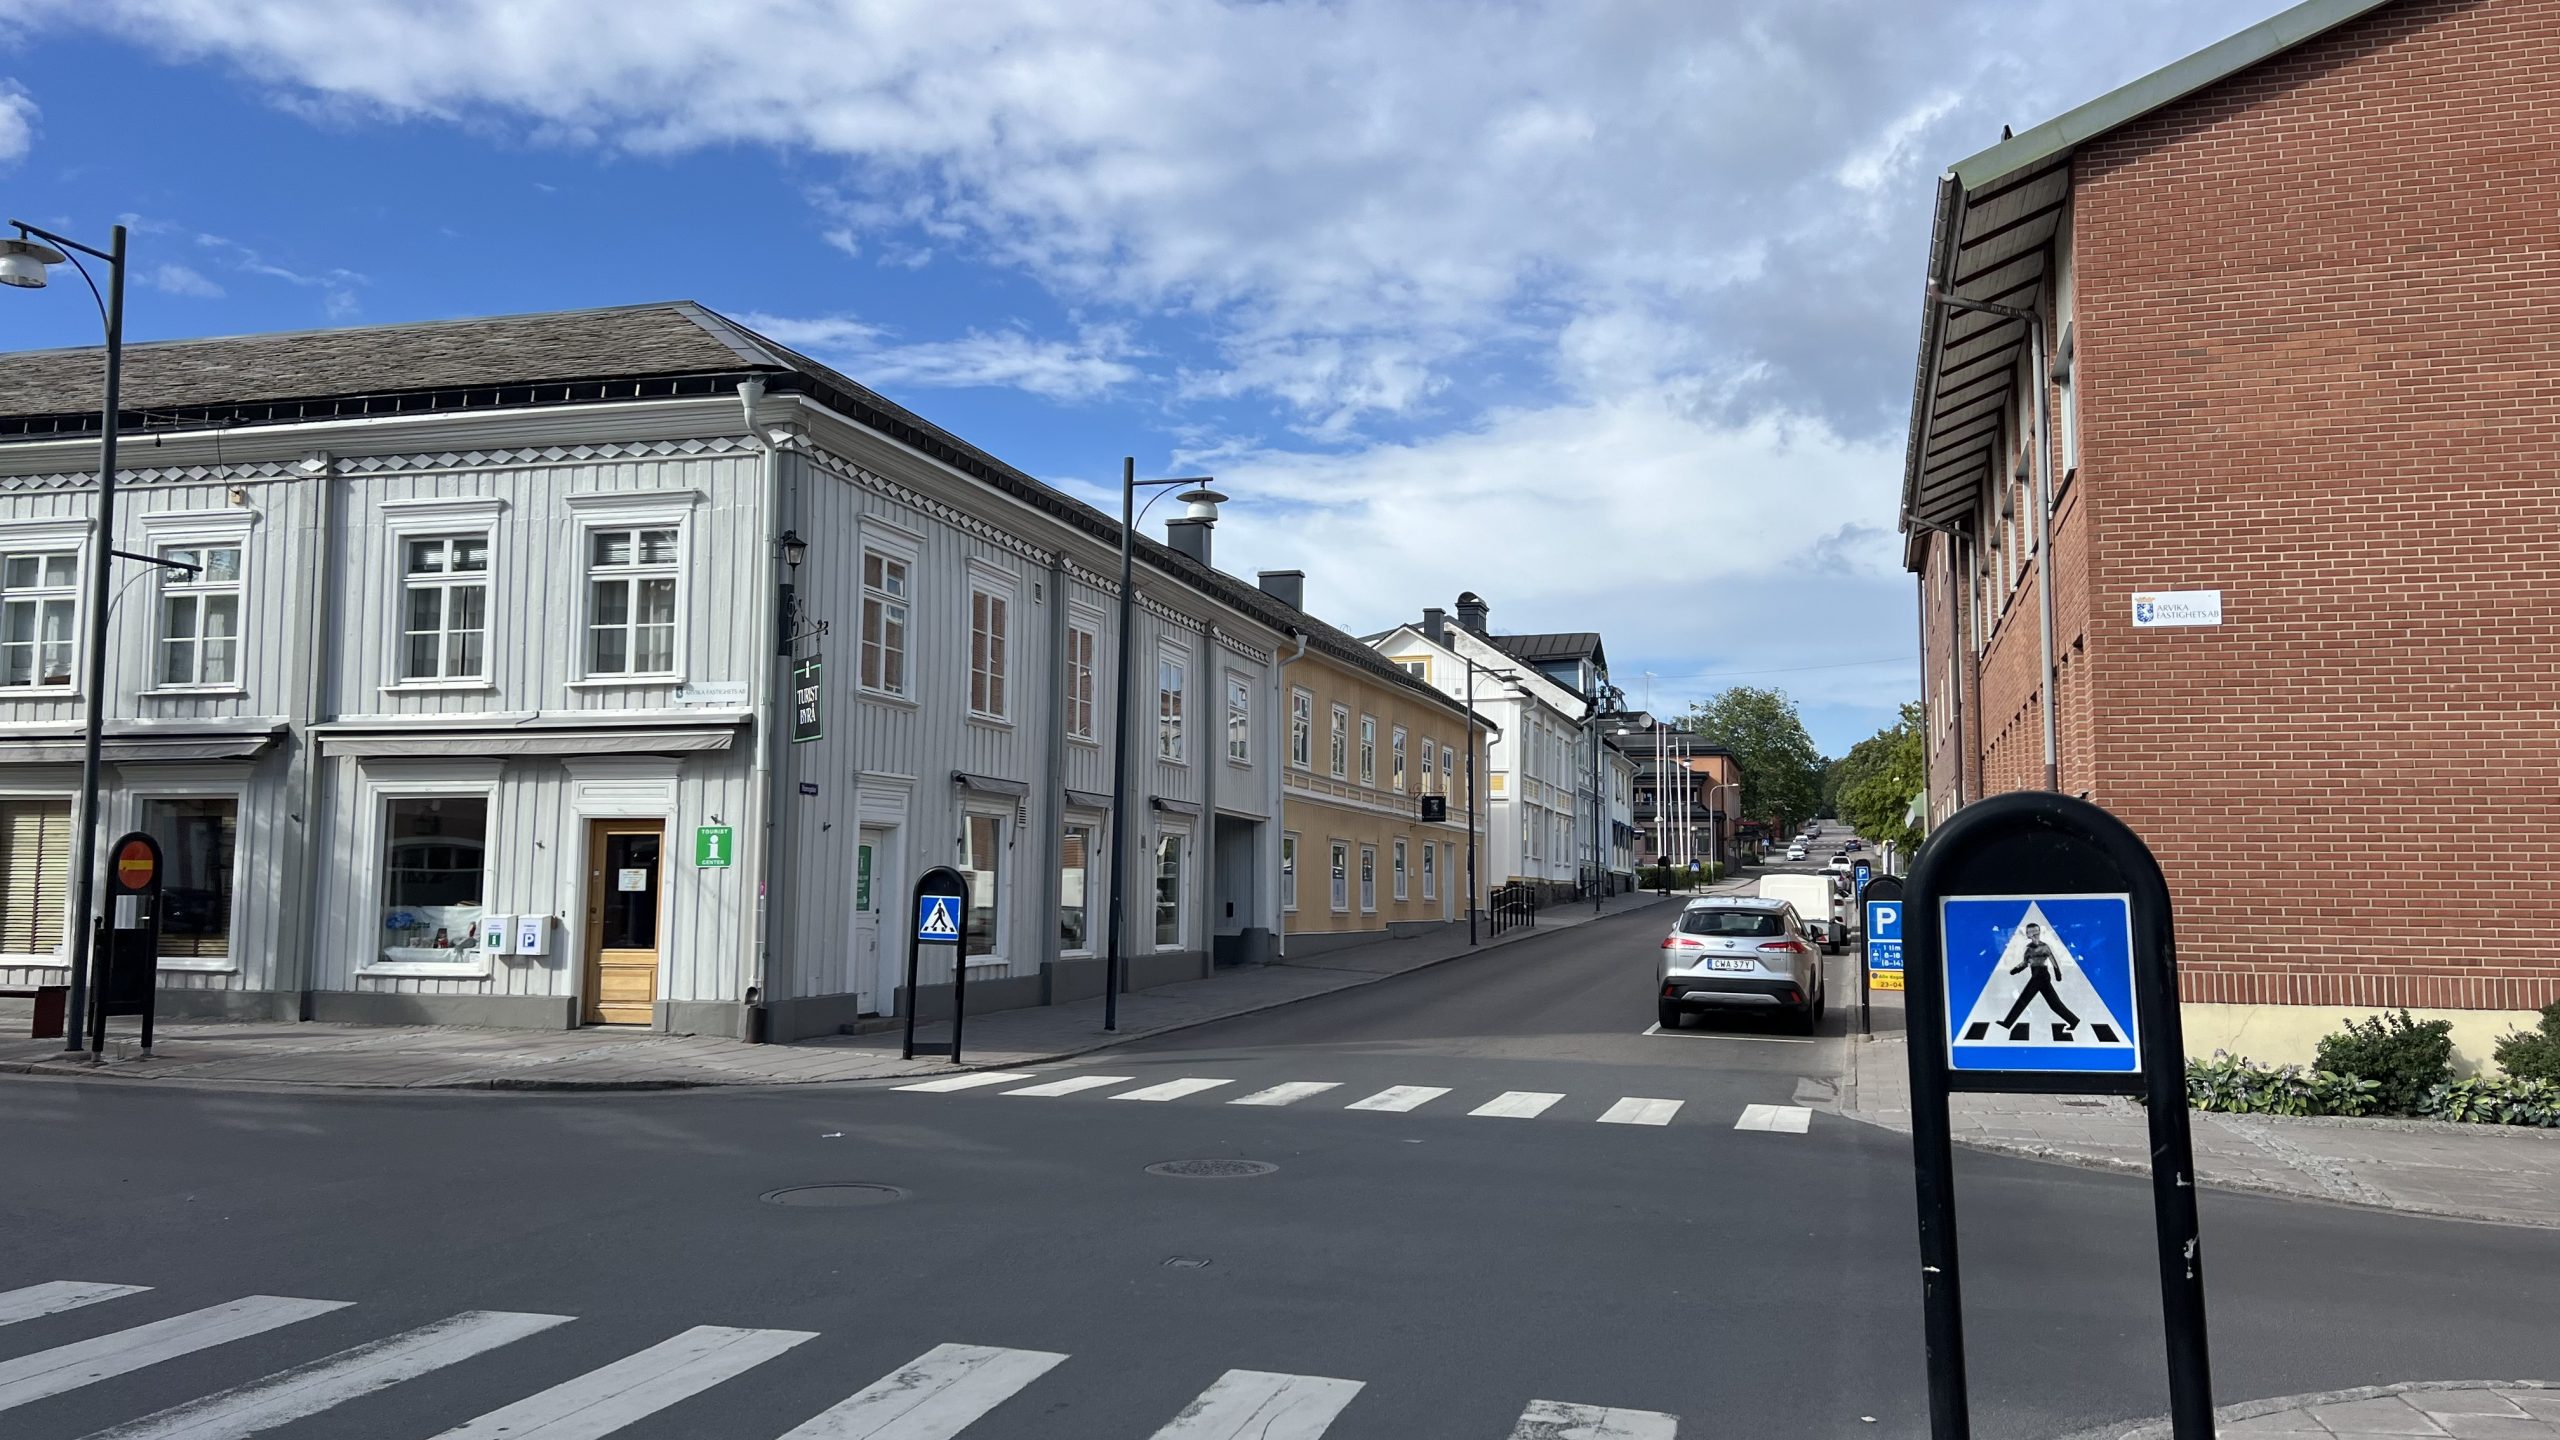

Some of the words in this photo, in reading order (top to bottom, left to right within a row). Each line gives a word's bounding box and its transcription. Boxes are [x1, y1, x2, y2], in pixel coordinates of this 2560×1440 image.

[2157, 611, 2207, 619] FASTIGHETS
[797, 686, 819, 705] TURIST
[800, 703, 816, 725] BYRÅ
[1876, 907, 1897, 935] P
[1734, 961, 1750, 969] 37Y
